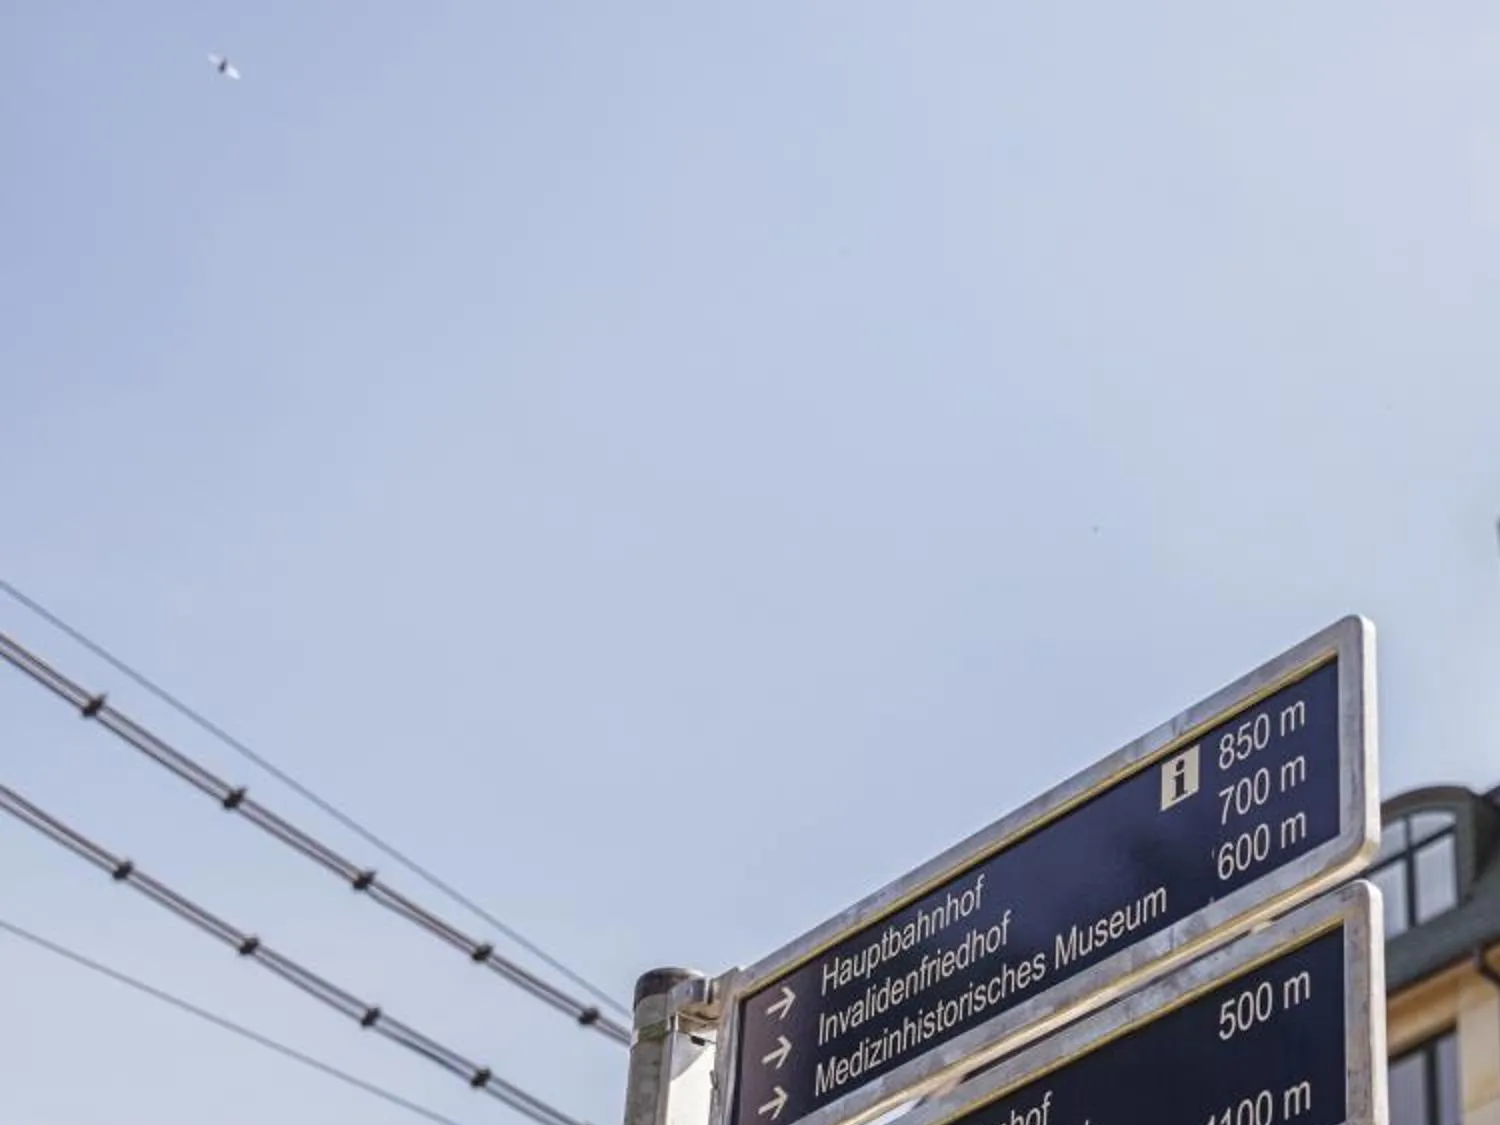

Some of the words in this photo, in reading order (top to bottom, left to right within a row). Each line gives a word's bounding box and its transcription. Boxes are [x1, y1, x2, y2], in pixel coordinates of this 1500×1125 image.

[815, 954, 1047, 1097] Medizinhistorisches
[1054, 886, 1167, 970] Museum
[1217, 823, 1270, 881] 600
[1280, 810, 1307, 848] m
[818, 910, 1012, 1046] Invalidenfriedhof
[1218, 767, 1270, 826] 700
[1280, 755, 1306, 792] m
[821, 874, 985, 997] Hauptbahnhof
[1218, 713, 1270, 770] 850
[1280, 699, 1306, 736] m
[1218, 981, 1273, 1040] 500
[1283, 970, 1310, 1009] m
[1283, 1080, 1311, 1120] m
